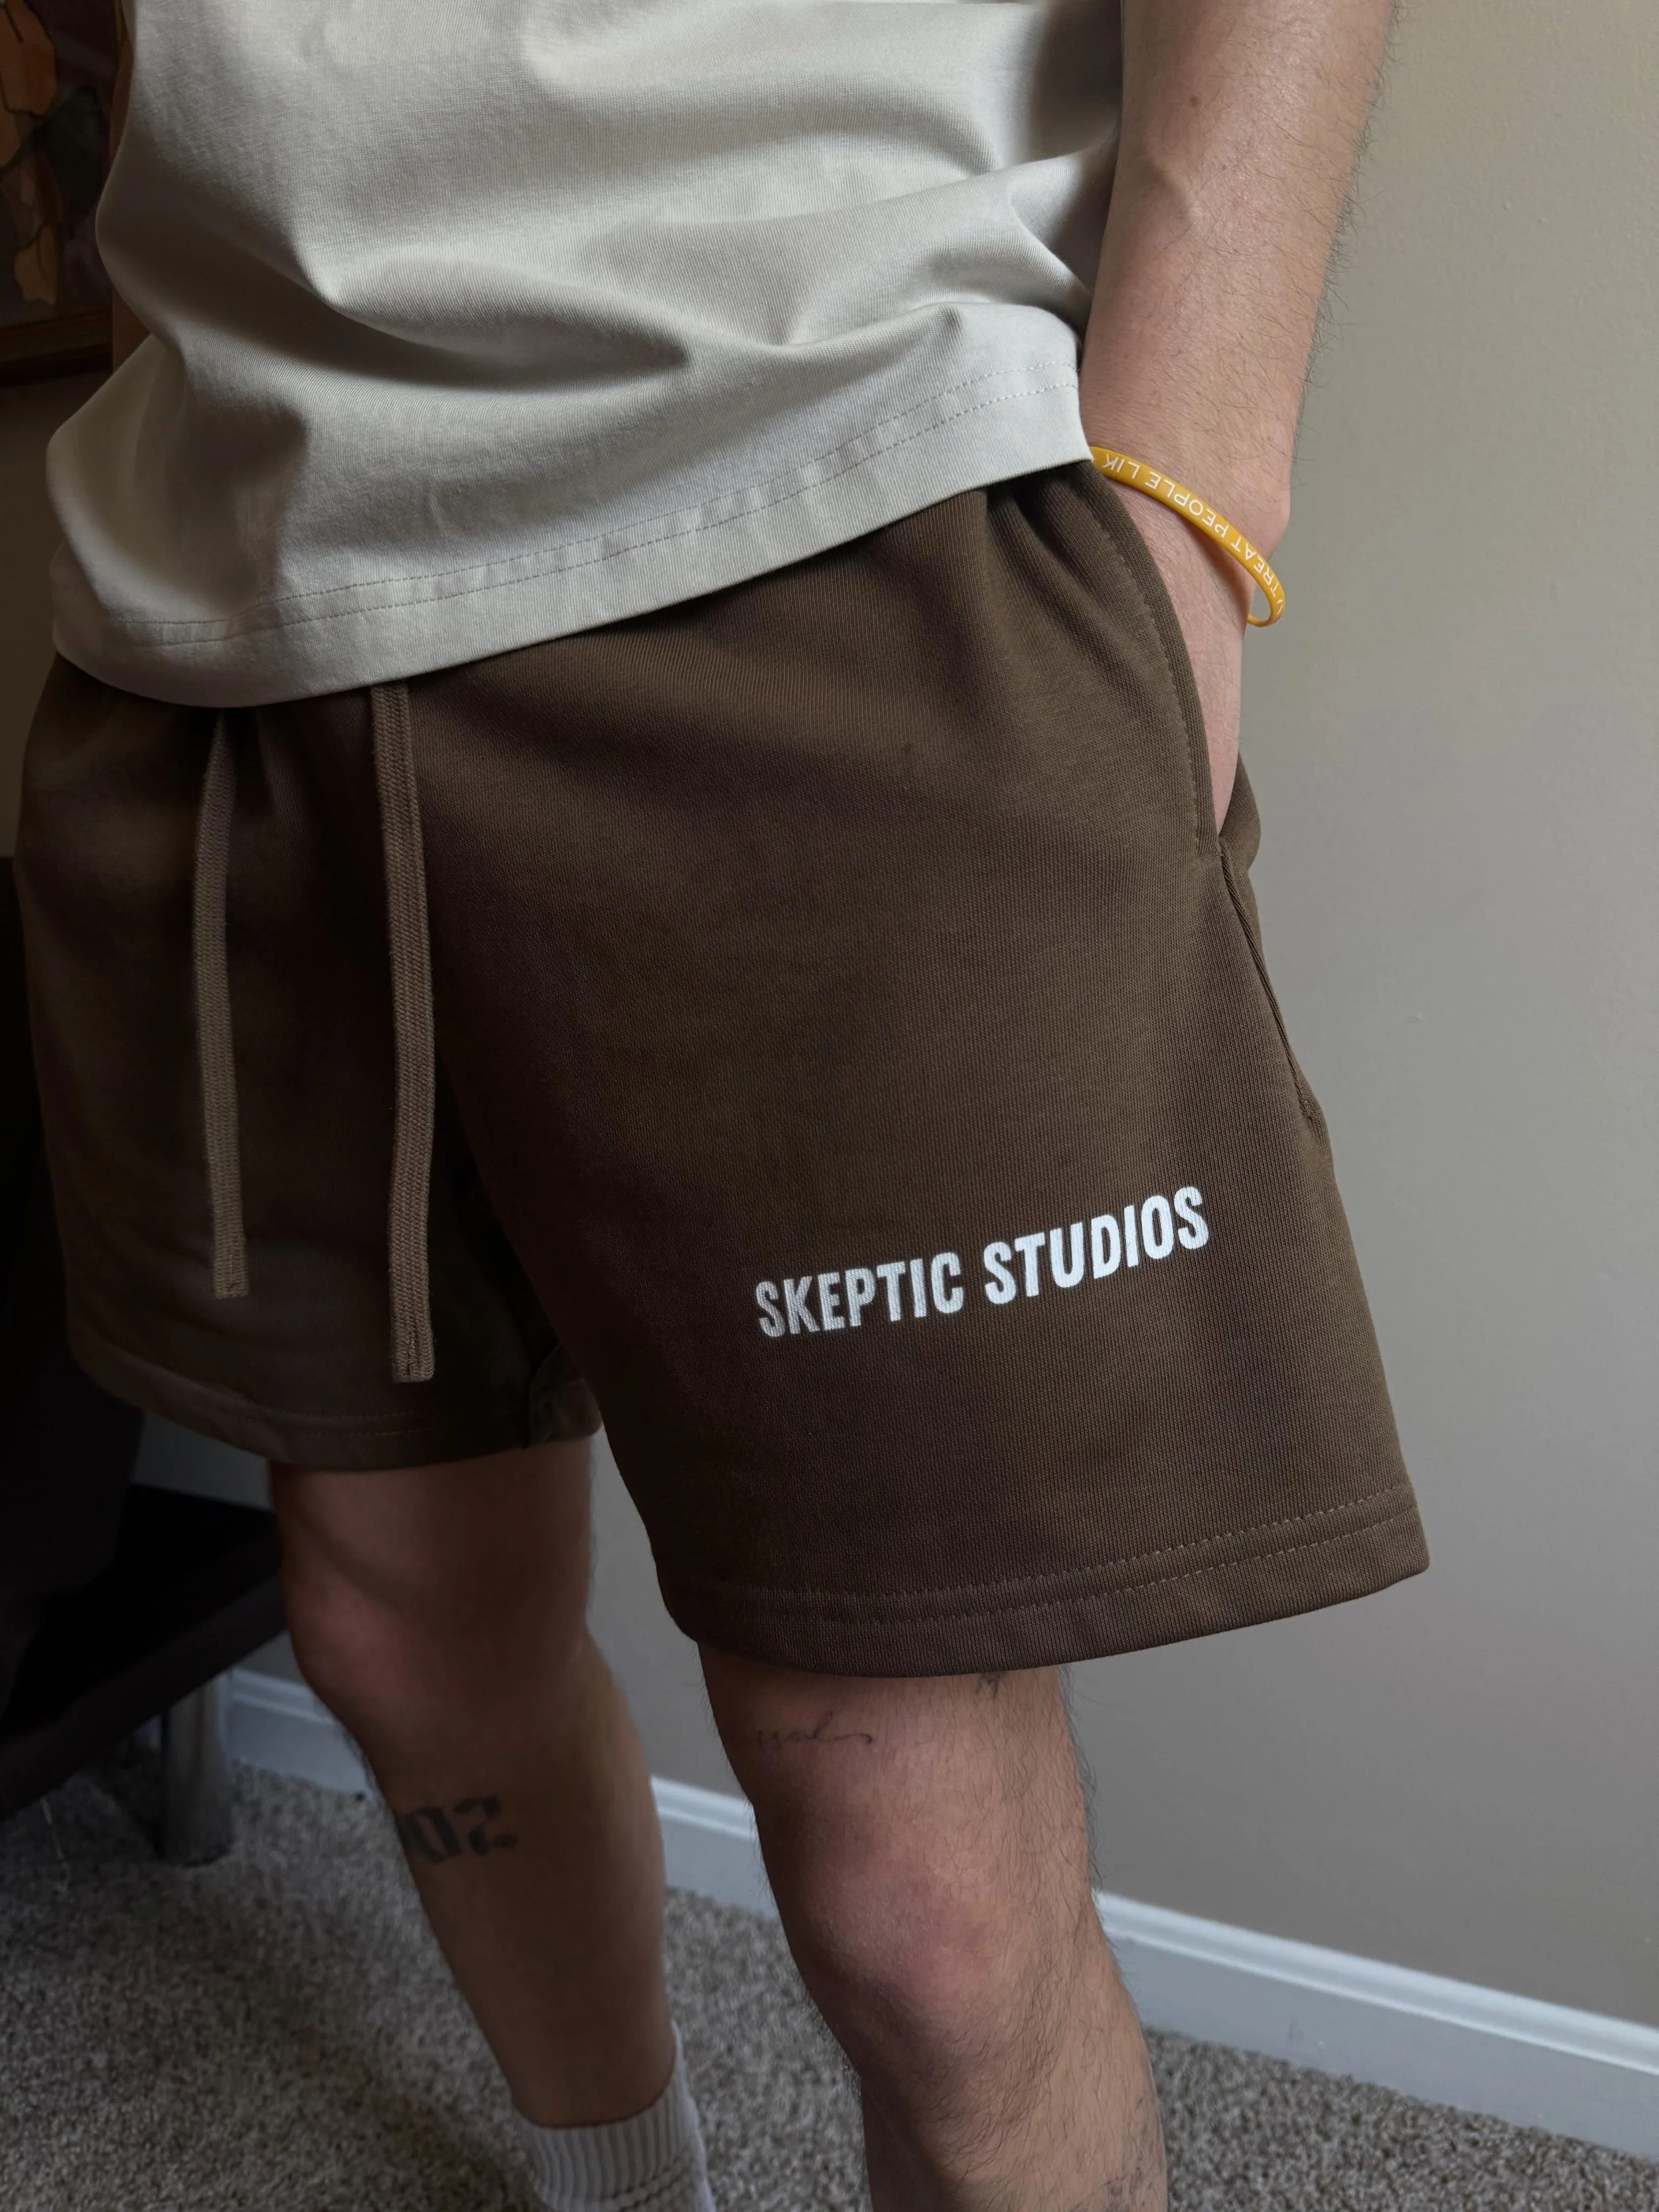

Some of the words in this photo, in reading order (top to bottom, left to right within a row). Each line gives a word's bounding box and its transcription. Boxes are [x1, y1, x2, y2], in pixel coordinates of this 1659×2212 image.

[1145, 471, 1229, 538] PEOPLE
[1231, 536, 1280, 598] TREAT
[756, 1252, 964, 1337] SKEPTIC
[983, 1186, 1209, 1305] STUDIOS
[397, 1795, 518, 1864] 02
